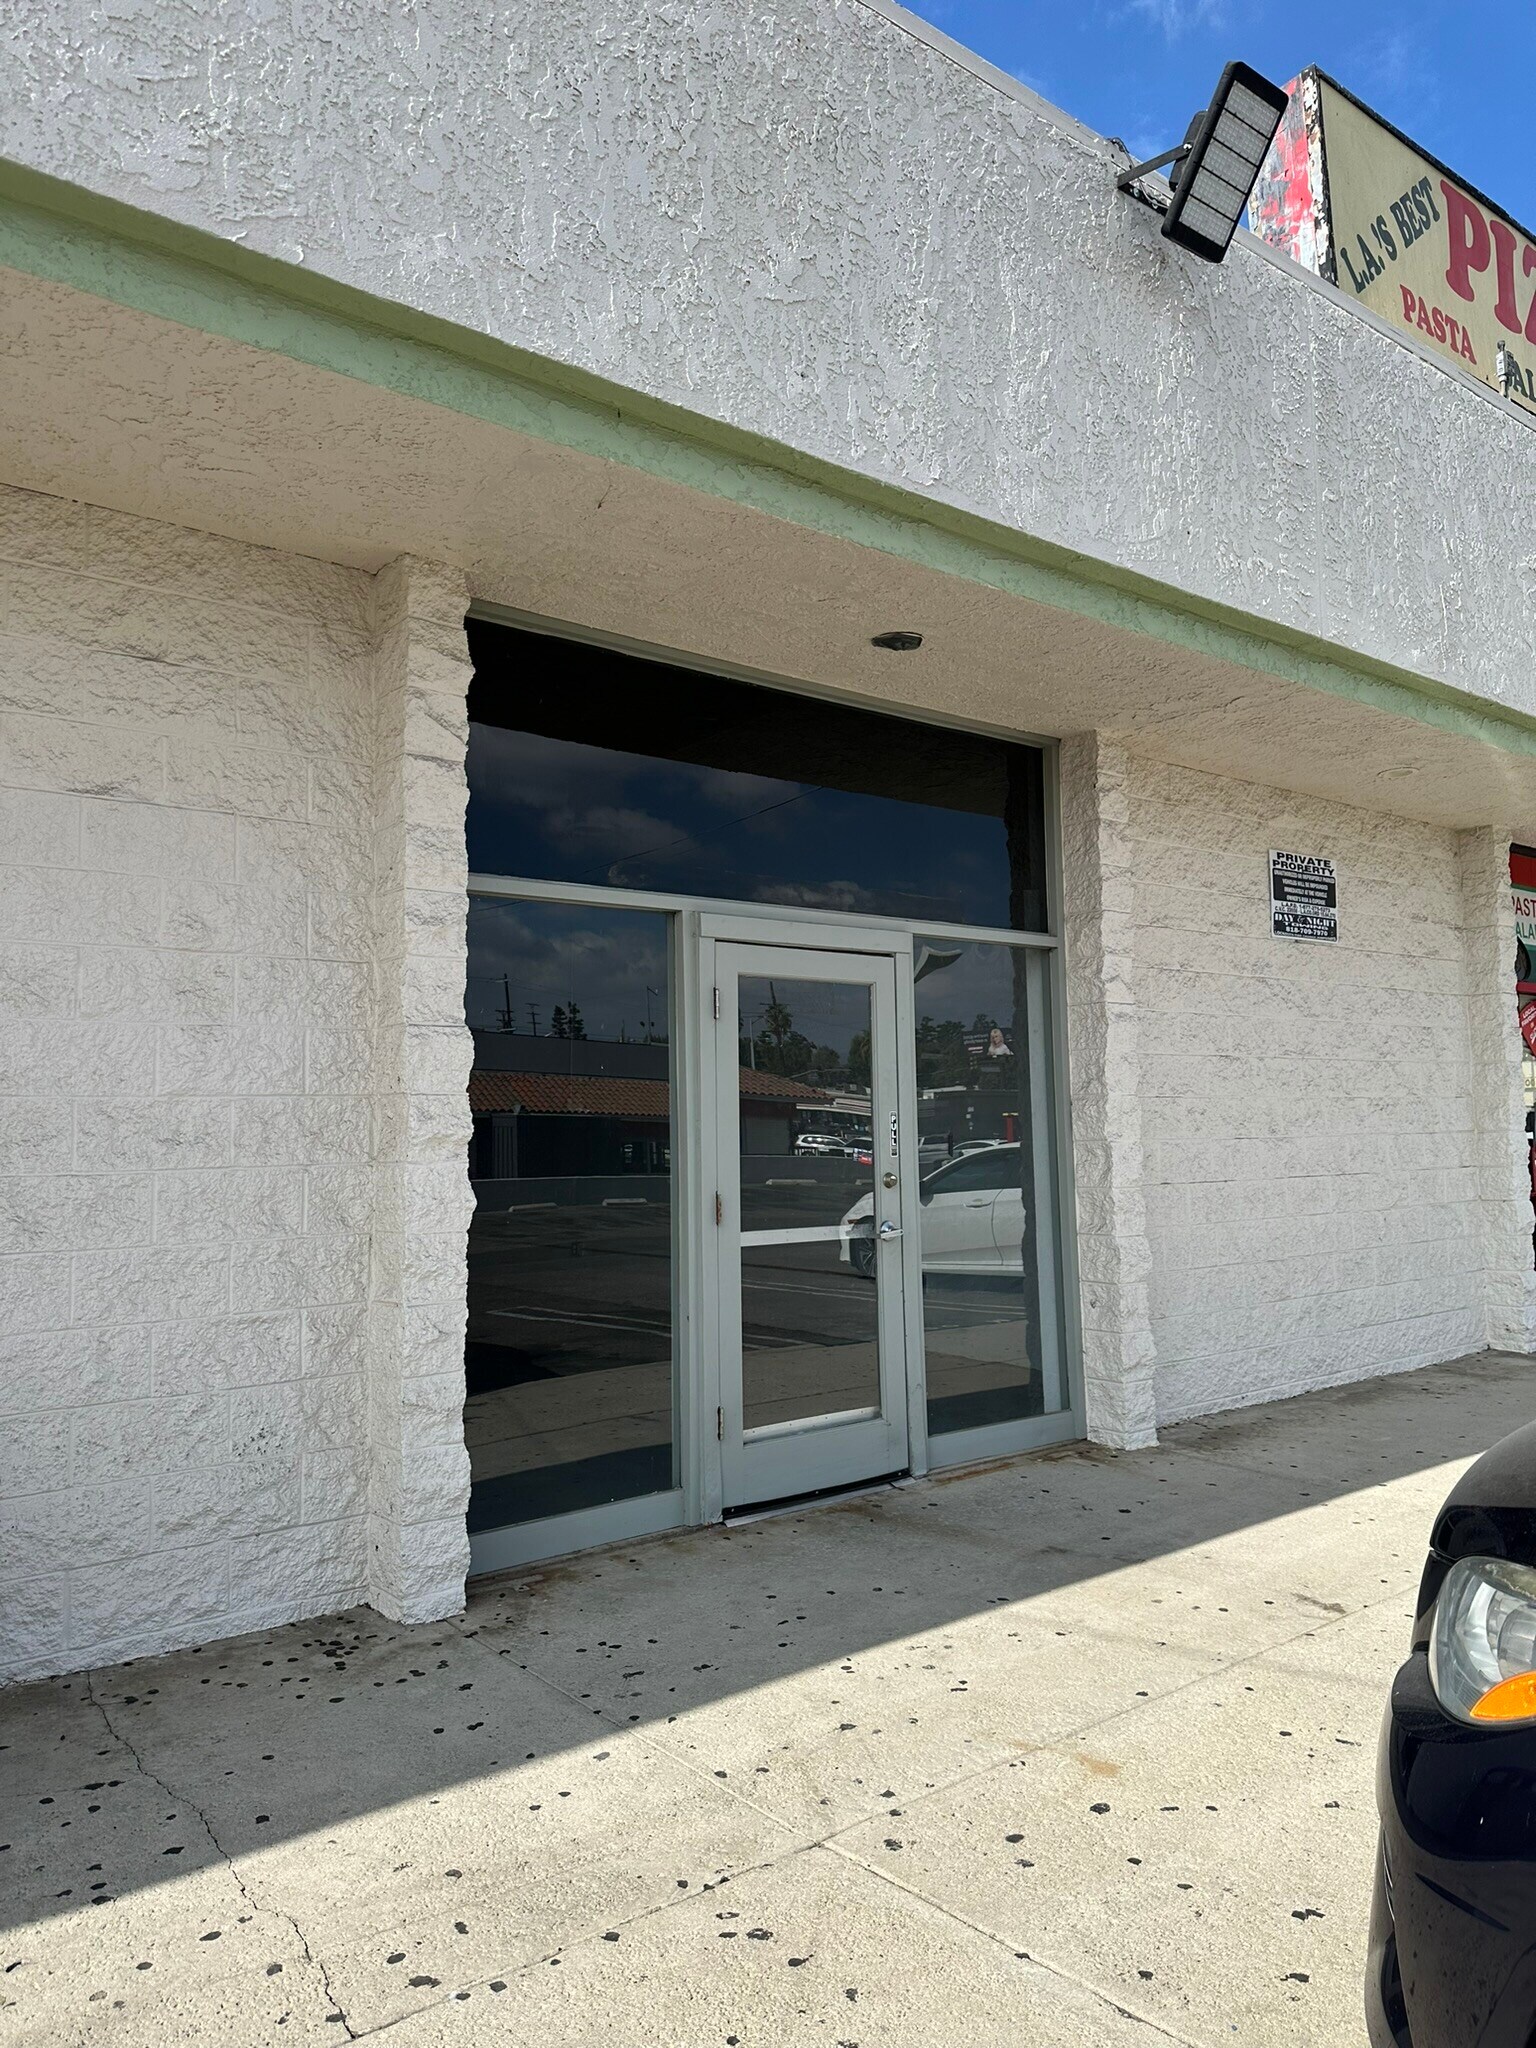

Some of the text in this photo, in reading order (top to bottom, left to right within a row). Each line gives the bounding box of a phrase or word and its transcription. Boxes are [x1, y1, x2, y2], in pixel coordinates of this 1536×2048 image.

[1389, 175, 1441, 249] BEST
[1400, 283, 1477, 365] PASTA
[1272, 859, 1335, 876] PROPERTY
[1276, 851, 1332, 868] PRIVATE
[1511, 895, 1536, 918] AST
[1274, 913, 1295, 923] DAY
[1306, 916, 1336, 928] NIGHT
[1282, 921, 1329, 931] TOWING
[1515, 921, 1536, 940] ALA
